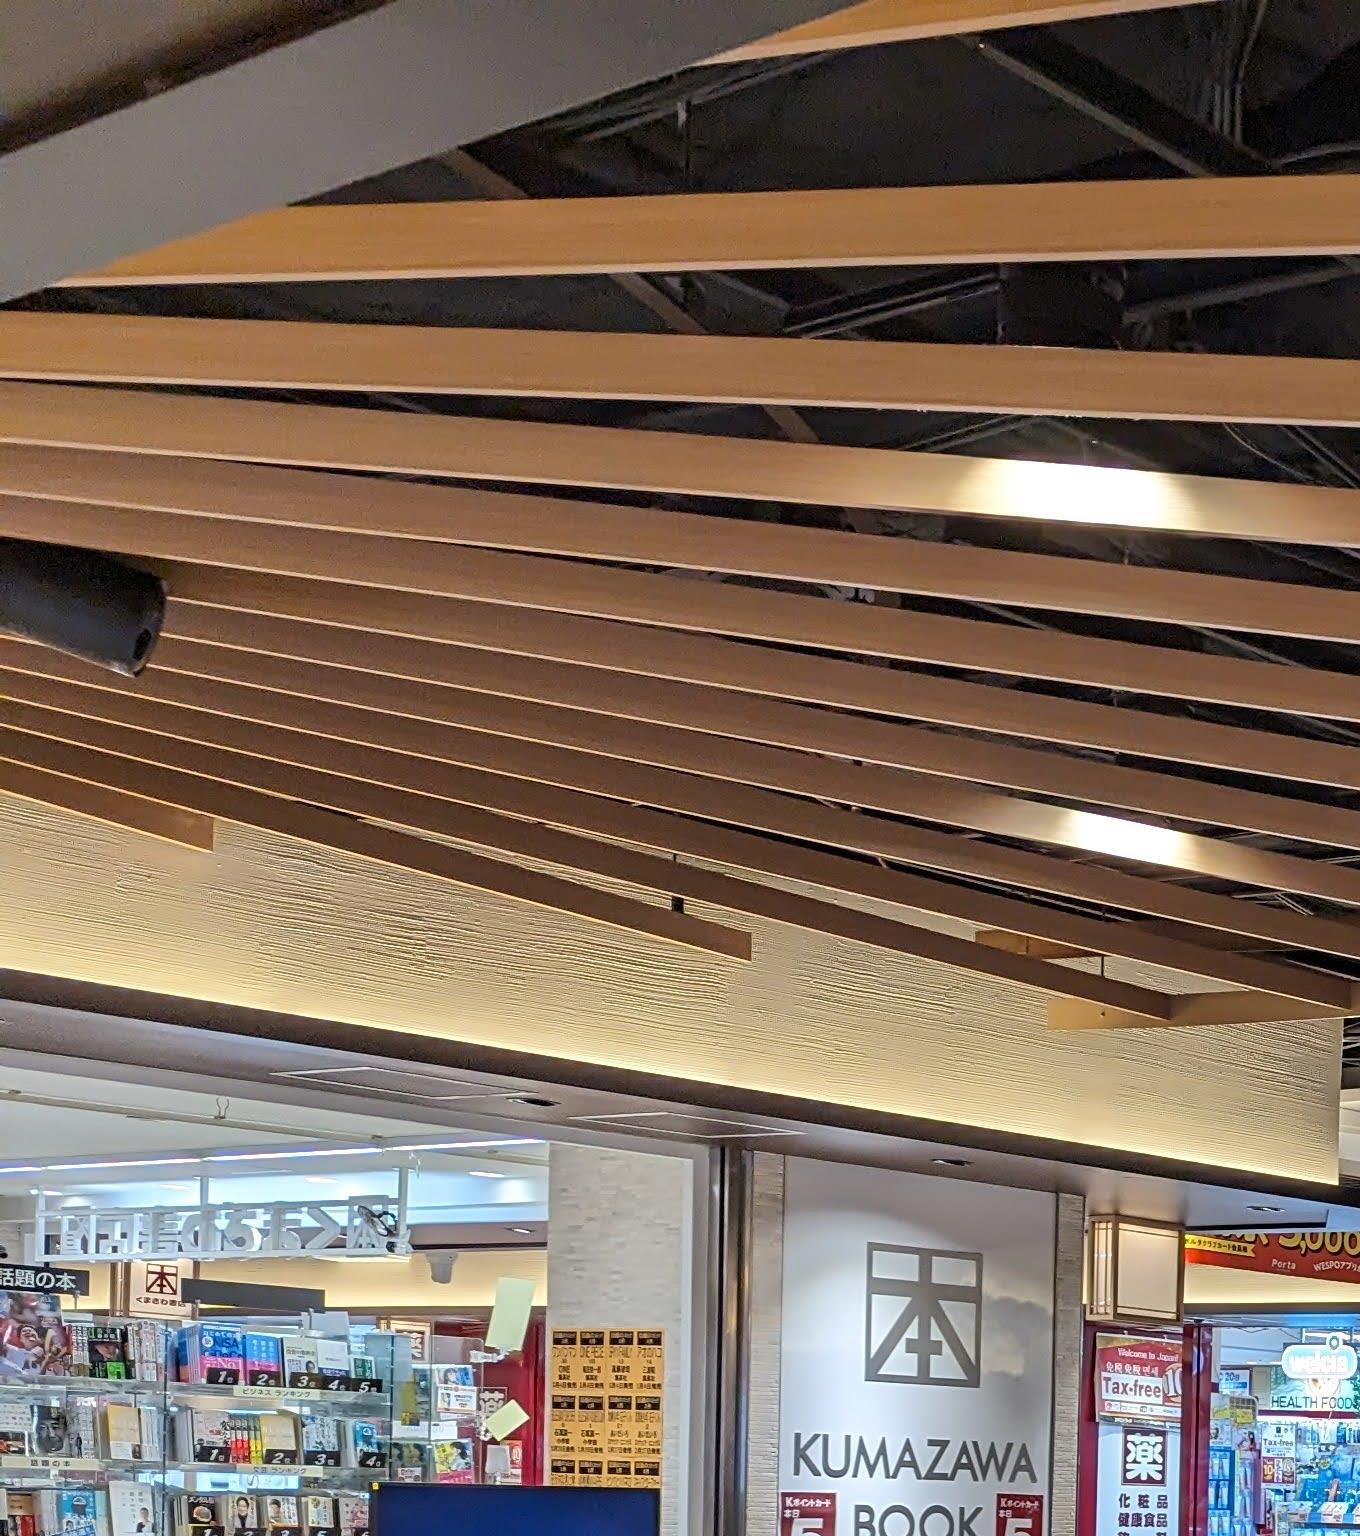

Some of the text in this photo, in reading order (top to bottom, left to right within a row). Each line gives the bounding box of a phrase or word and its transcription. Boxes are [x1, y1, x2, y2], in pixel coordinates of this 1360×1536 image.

[1271, 1258, 1296, 1270] Porta
[1117, 1347, 1148, 1359] Welcome
[1148, 1352, 1156, 1360] to
[274, 1389, 311, 1399] ランキング
[1102, 1376, 1162, 1398] Tax-free
[1271, 1395, 1318, 1409] HEALTH
[793, 1432, 1038, 1484] KUMAZAWA
[1126, 1433, 1164, 1480] 薬
[271, 1466, 308, 1475] ランキング
[1118, 1512, 1168, 1528] 健康食品
